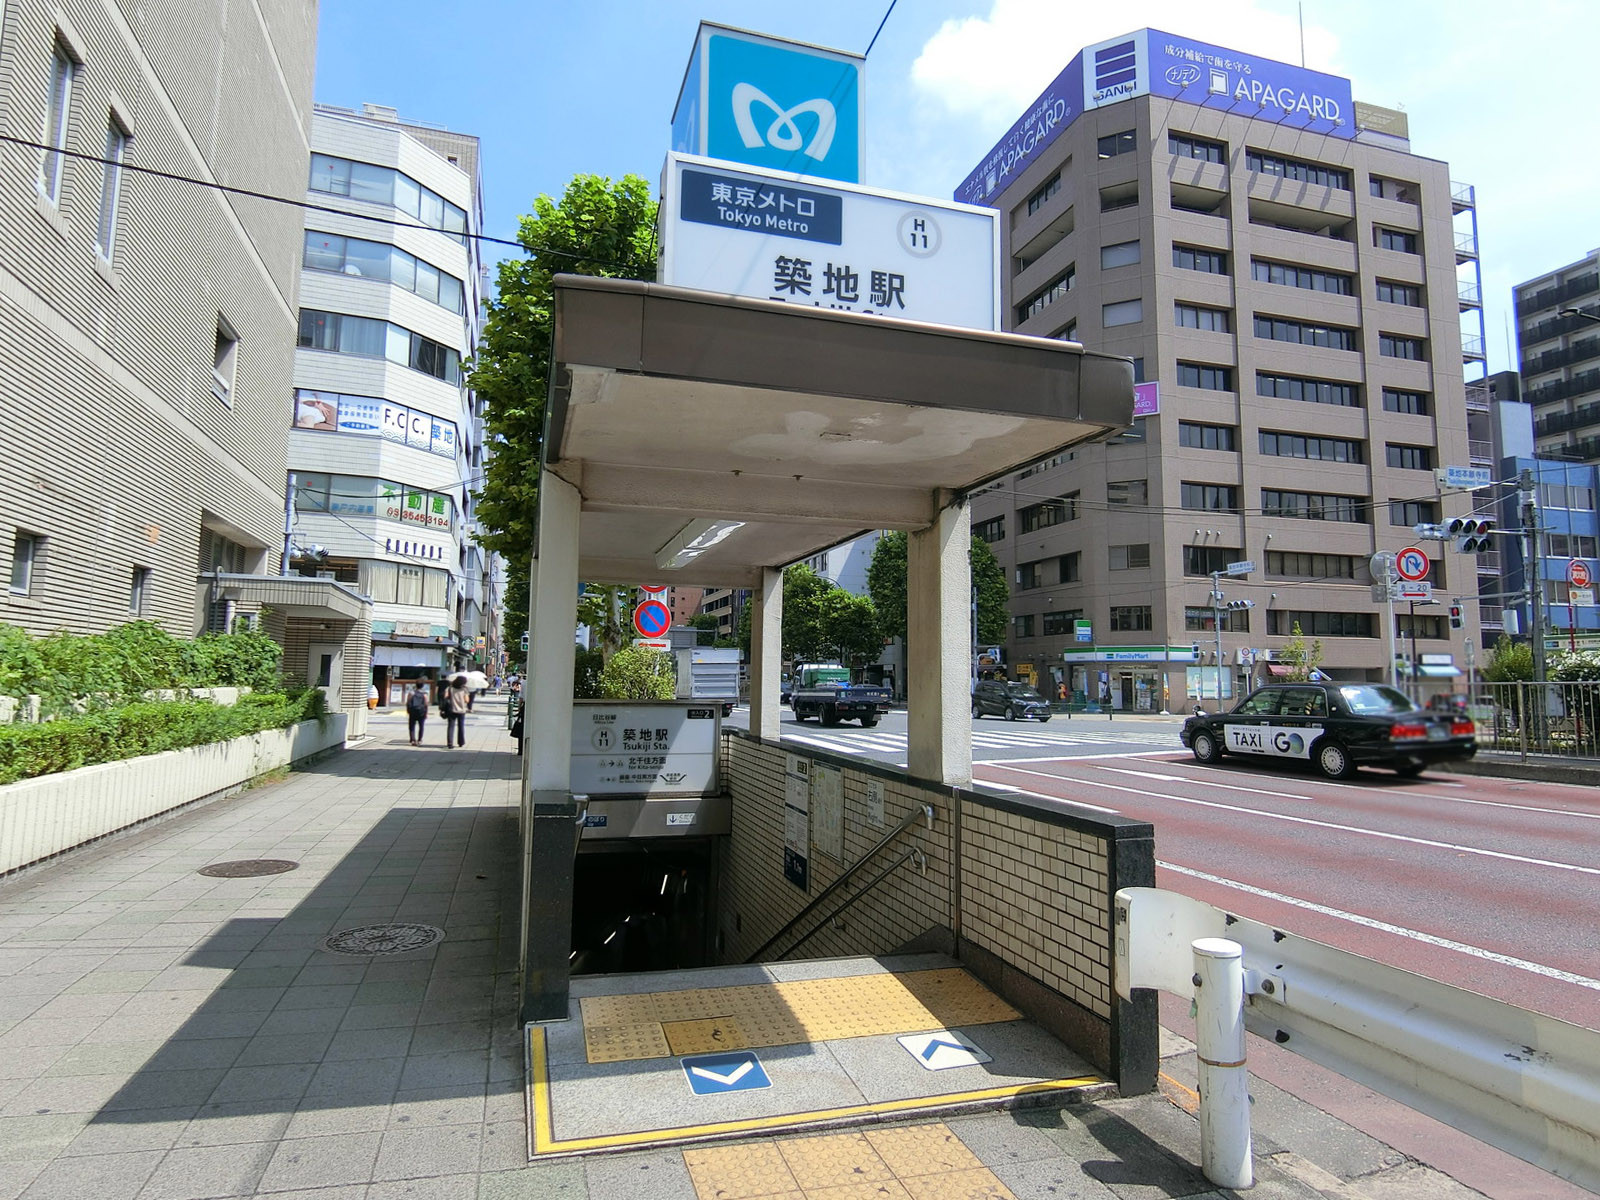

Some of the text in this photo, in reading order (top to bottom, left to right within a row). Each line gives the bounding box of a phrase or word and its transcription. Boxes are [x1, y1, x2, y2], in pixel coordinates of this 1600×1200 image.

[1165, 45, 1252, 75] 成分補給で歯を守る
[1171, 70, 1196, 81] ナノテク
[1235, 77, 1340, 121] APAGARD
[998, 99, 1066, 184] APAGARD
[711, 182, 815, 218] 東京メトロ
[718, 206, 809, 234] Tokyo Metro
[913, 219, 925, 233] H
[910, 233, 929, 249] 11
[774, 255, 906, 310] 築地駅
[432, 424, 453, 444] 築地
[382, 482, 446, 515] 不動産
[704, 710, 710, 719] 2
[598, 739, 609, 747] 11
[623, 728, 668, 741] 築地駅
[1233, 732, 1305, 755] TAXI GO
[623, 742, 670, 752] Tsukiji Sta.
[628, 756, 667, 765] 北千住方面
